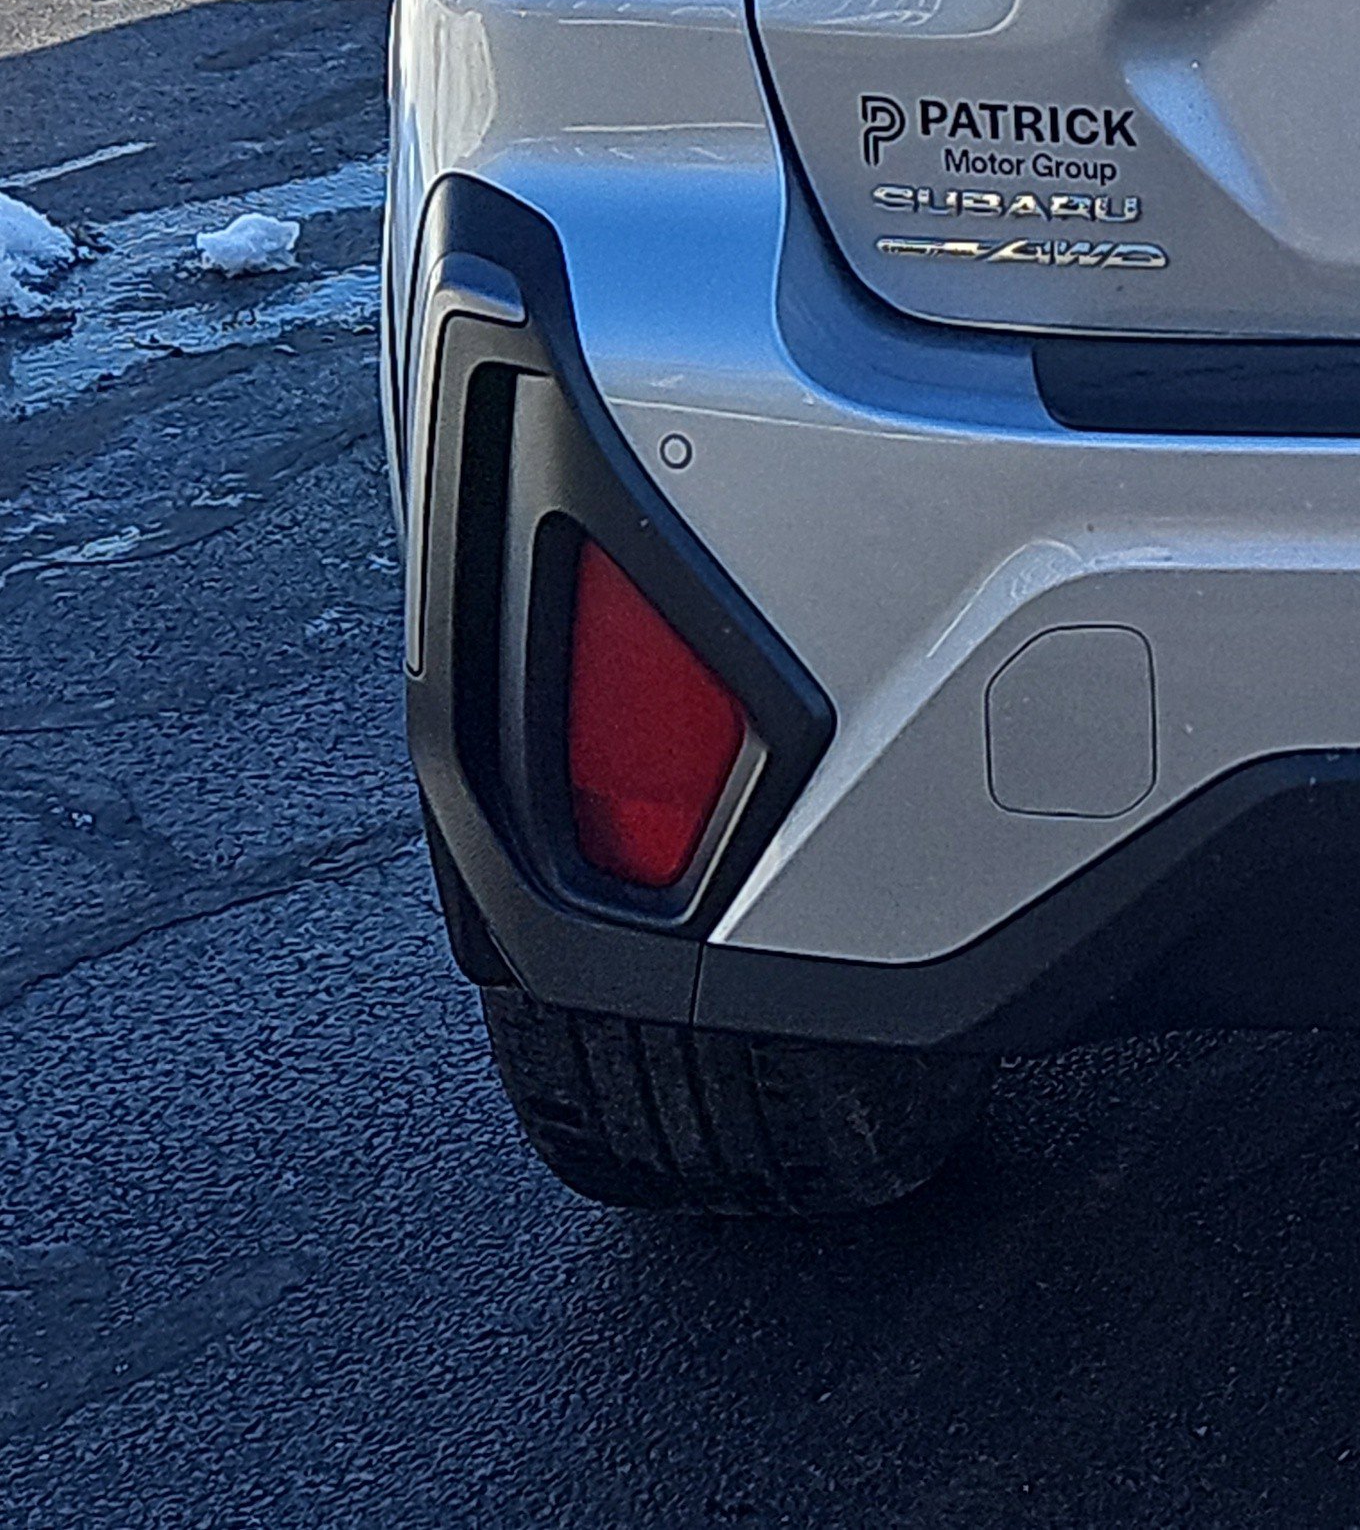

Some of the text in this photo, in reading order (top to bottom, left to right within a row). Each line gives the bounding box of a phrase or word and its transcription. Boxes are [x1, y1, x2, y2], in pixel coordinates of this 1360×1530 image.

[919, 99, 1137, 147] PATRICK
[944, 149, 1117, 185] Motor Group
[871, 184, 1142, 223] SUBARU
[984, 236, 1170, 269] AWD
